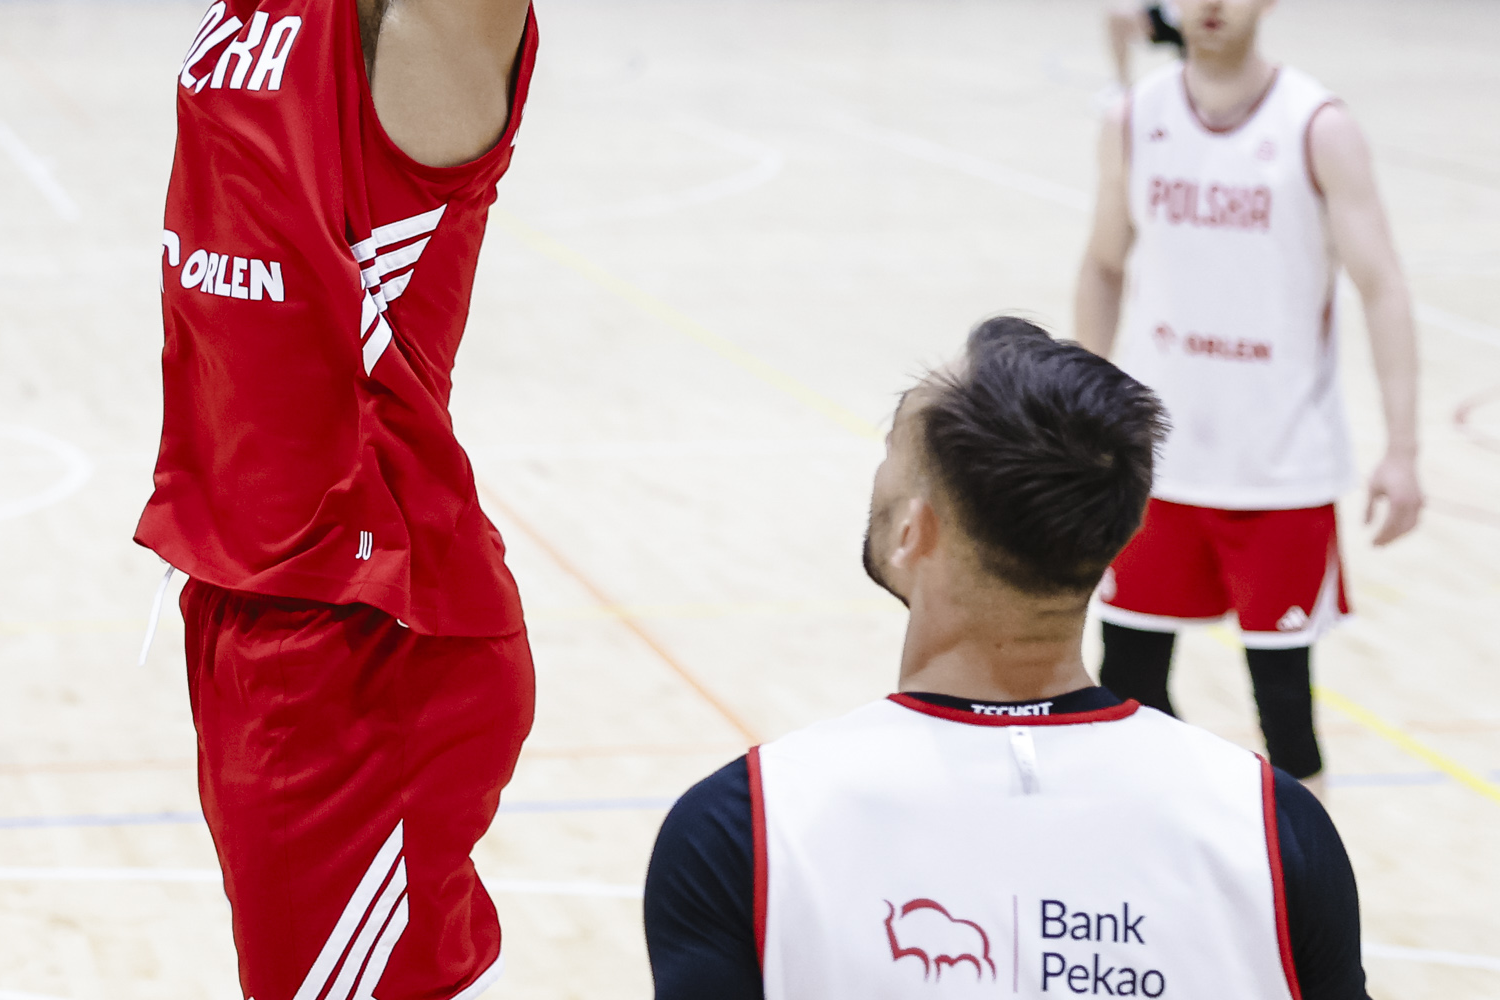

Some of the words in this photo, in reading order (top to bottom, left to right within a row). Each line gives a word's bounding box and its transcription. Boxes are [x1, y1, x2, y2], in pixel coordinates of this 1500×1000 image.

[1149, 175, 1272, 233] POLSKA
[180, 248, 285, 302] ORLEN
[1041, 898, 1146, 945] Bank
[1042, 951, 1165, 999] Pekao
